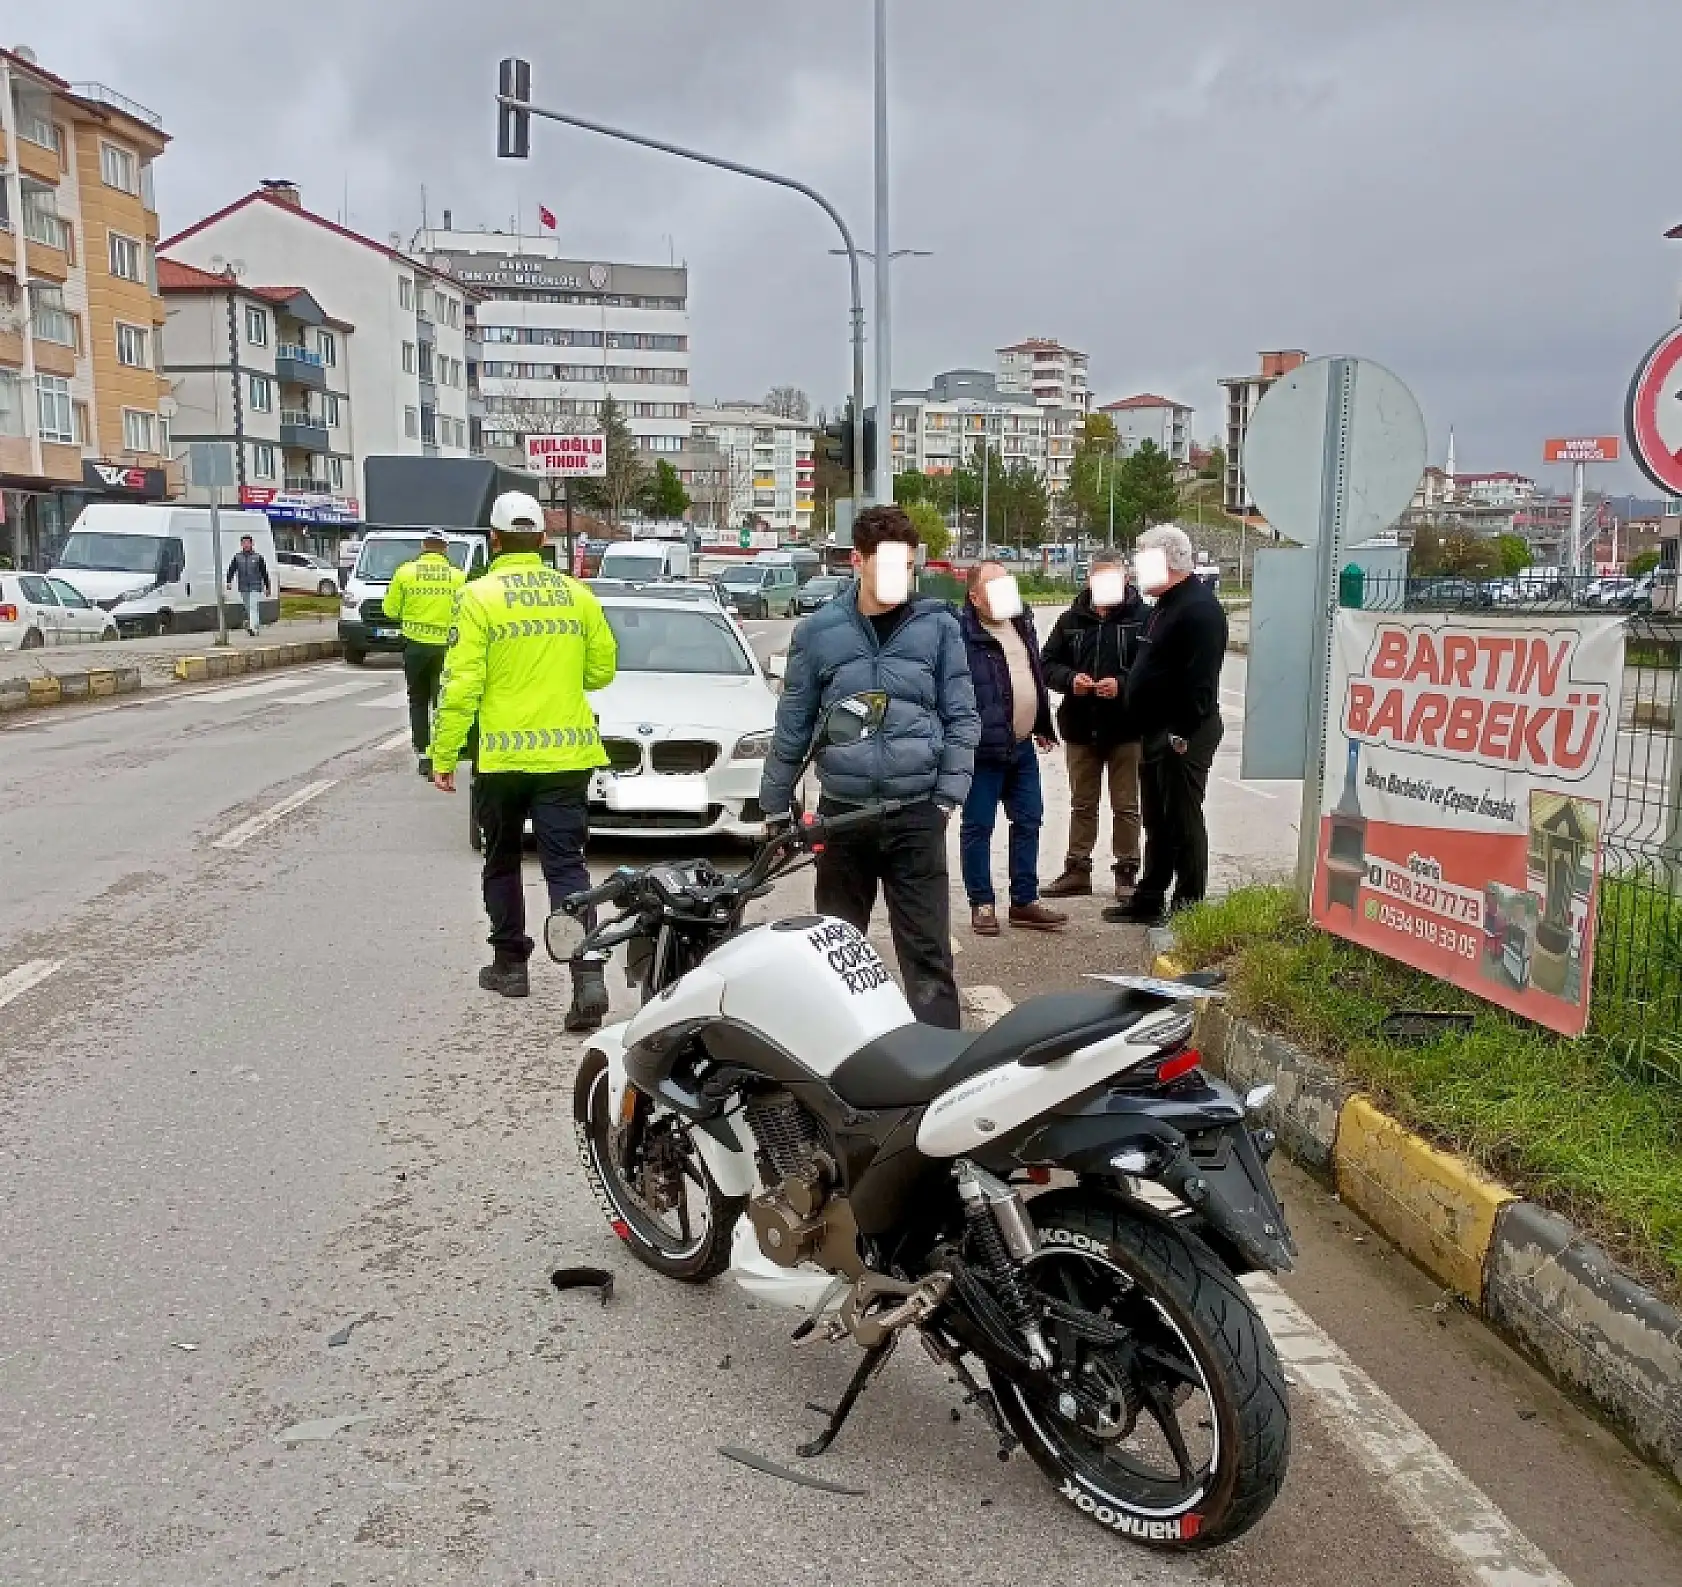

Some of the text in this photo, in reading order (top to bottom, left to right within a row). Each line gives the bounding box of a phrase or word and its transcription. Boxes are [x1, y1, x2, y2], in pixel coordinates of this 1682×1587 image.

[529, 436, 602, 456] KULOĞLU
[545, 455, 589, 468] FINDIK
[504, 589, 575, 608] POLİSİ
[1371, 631, 1571, 697] BARTIN
[1347, 683, 1602, 770] BARBEKÜ
